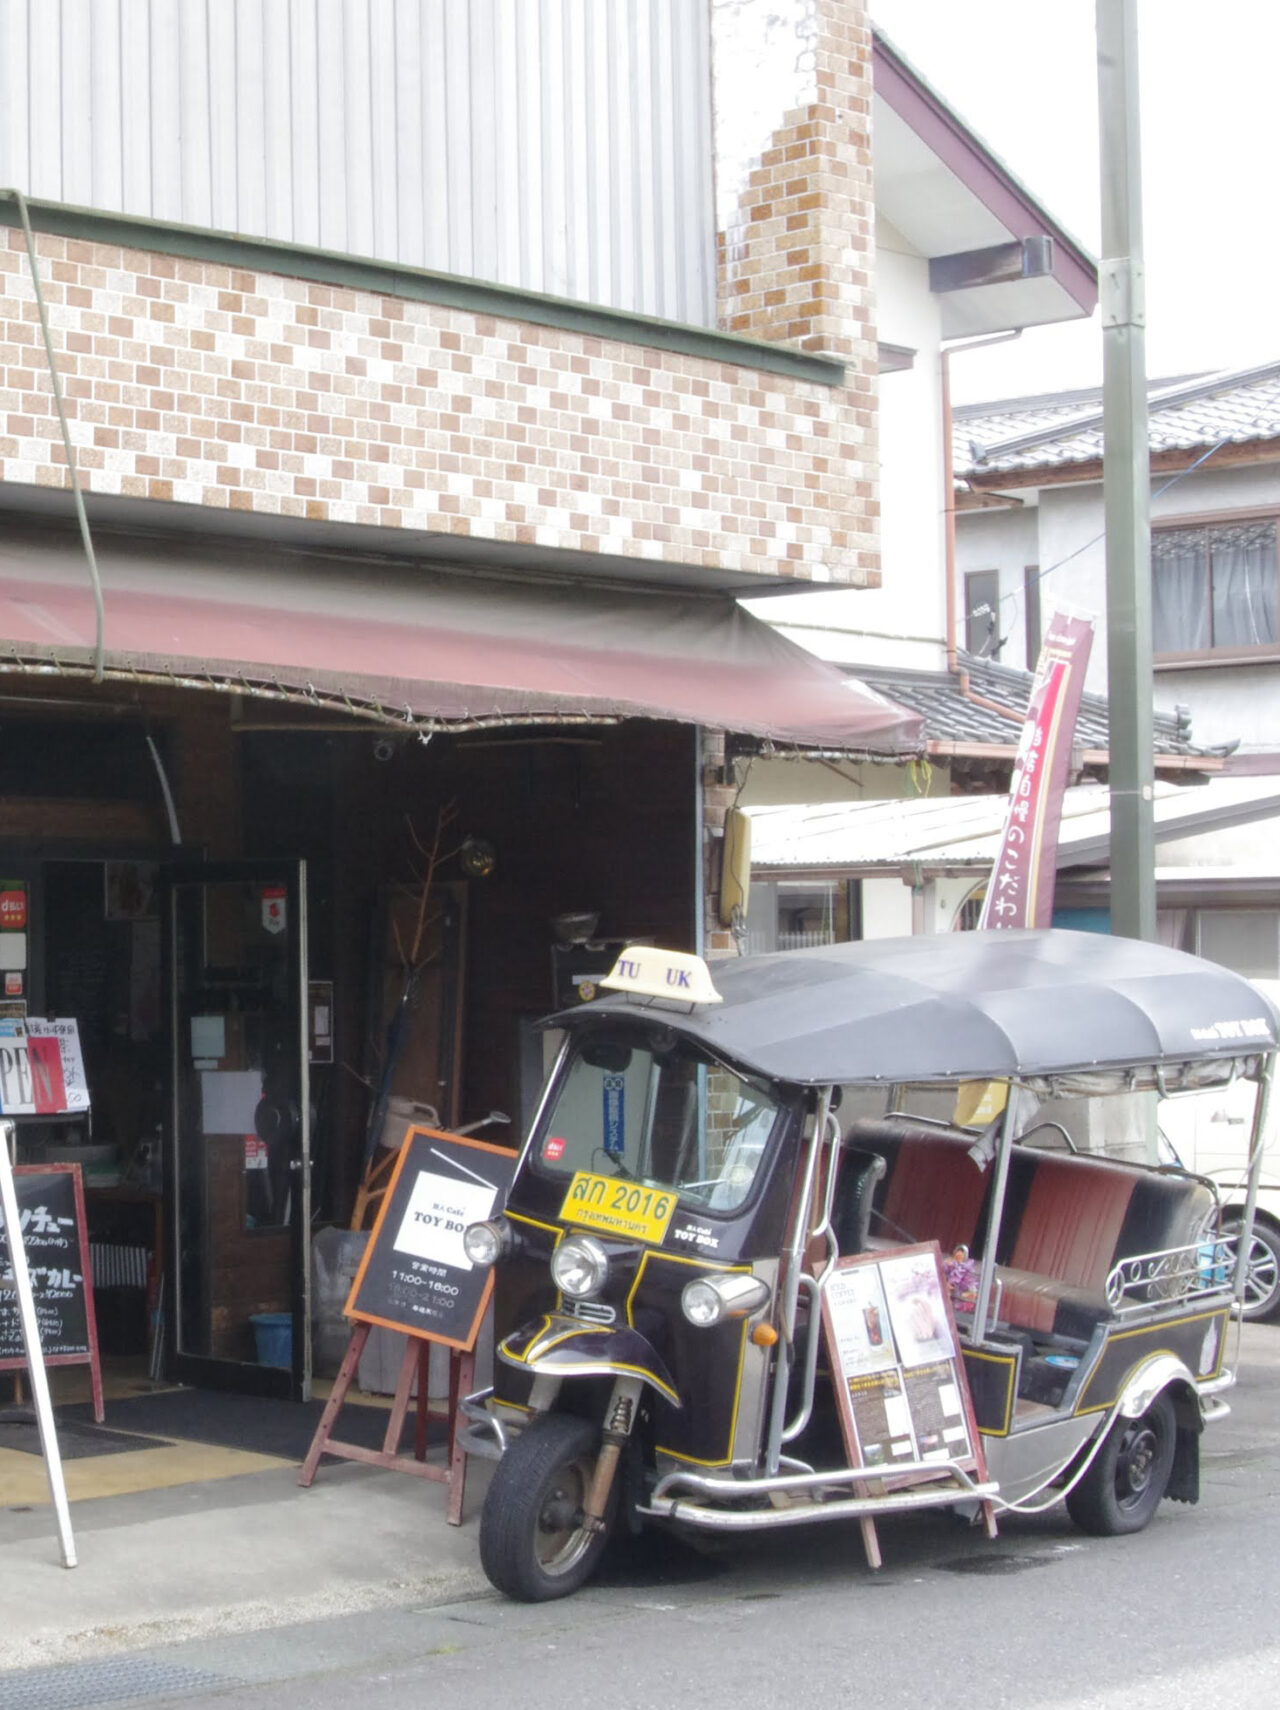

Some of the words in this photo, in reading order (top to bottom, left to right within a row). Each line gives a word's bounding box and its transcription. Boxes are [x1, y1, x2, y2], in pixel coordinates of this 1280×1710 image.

[611, 1186, 670, 1221] 2016
[414, 1211, 444, 1227] TOY
[445, 1219, 466, 1233] BO
[674, 1229, 697, 1242] TOY
[696, 1234, 719, 1249] BOX
